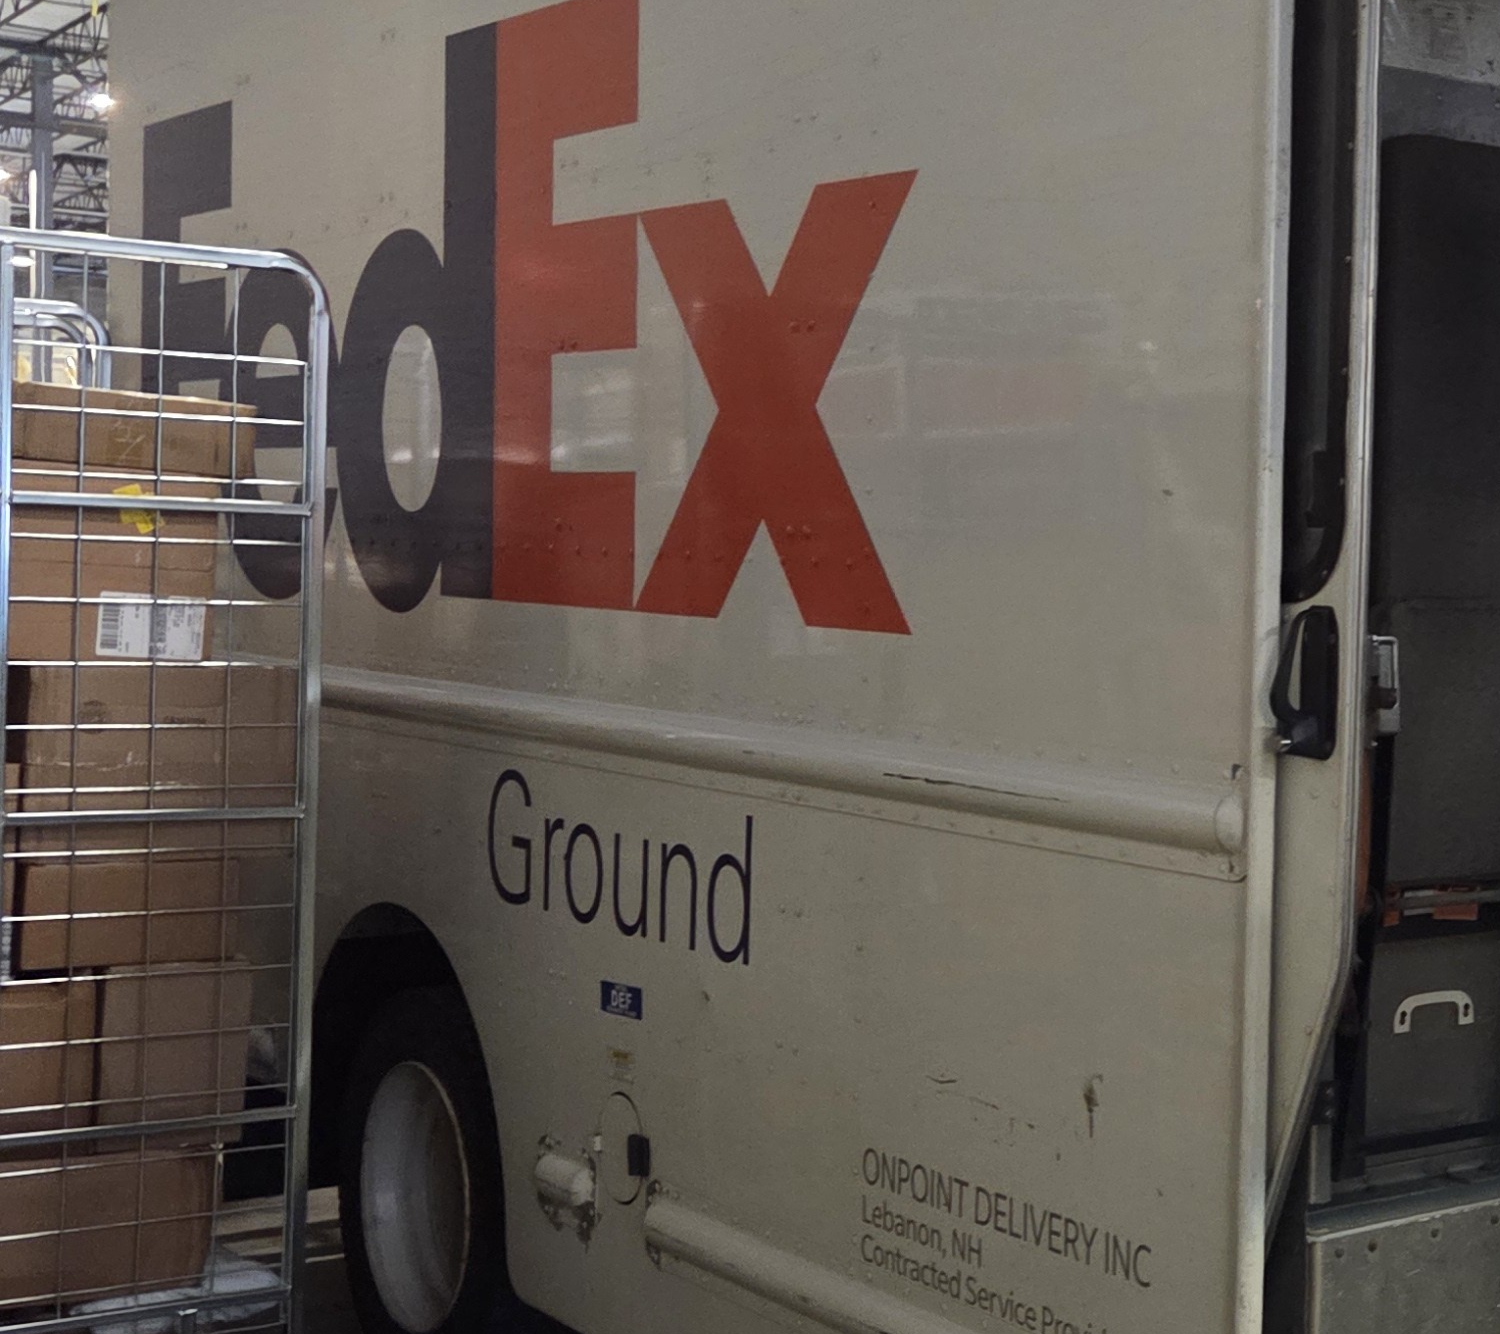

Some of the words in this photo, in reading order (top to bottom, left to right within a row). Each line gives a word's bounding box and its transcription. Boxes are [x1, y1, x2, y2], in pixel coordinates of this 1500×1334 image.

[487, 768, 753, 966] Ground
[611, 989, 632, 1010] DEF
[862, 1148, 969, 1218] ONPOINT
[975, 1186, 1098, 1265] DELIVERY
[1105, 1231, 1151, 1287] INC
[862, 1194, 946, 1258] Lebanon,
[951, 1228, 982, 1268] NH
[861, 1234, 961, 1299] Contracted
[965, 1276, 1037, 1330] Service
